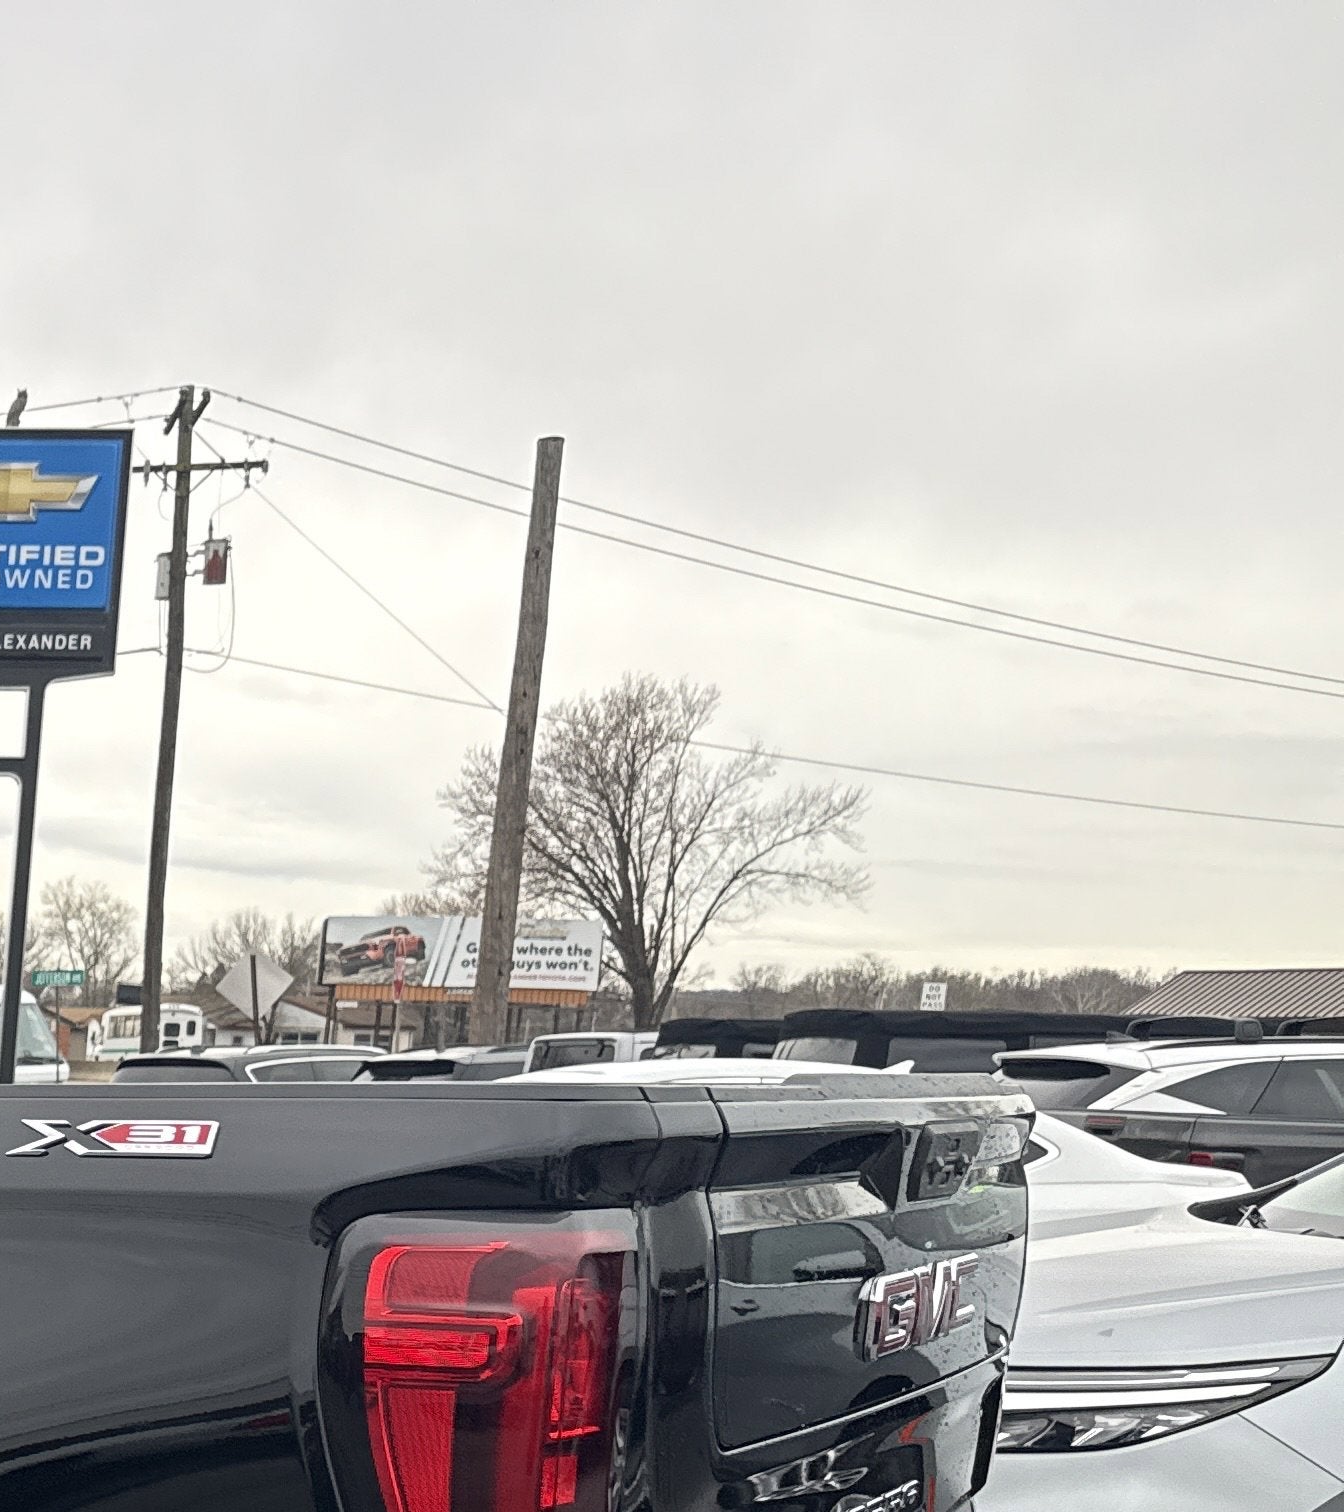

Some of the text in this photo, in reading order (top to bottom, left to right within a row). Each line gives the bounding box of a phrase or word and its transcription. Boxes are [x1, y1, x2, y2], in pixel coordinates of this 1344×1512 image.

[516, 943, 563, 957] where
[566, 943, 593, 957] the
[862, 1251, 979, 1361] GMC
